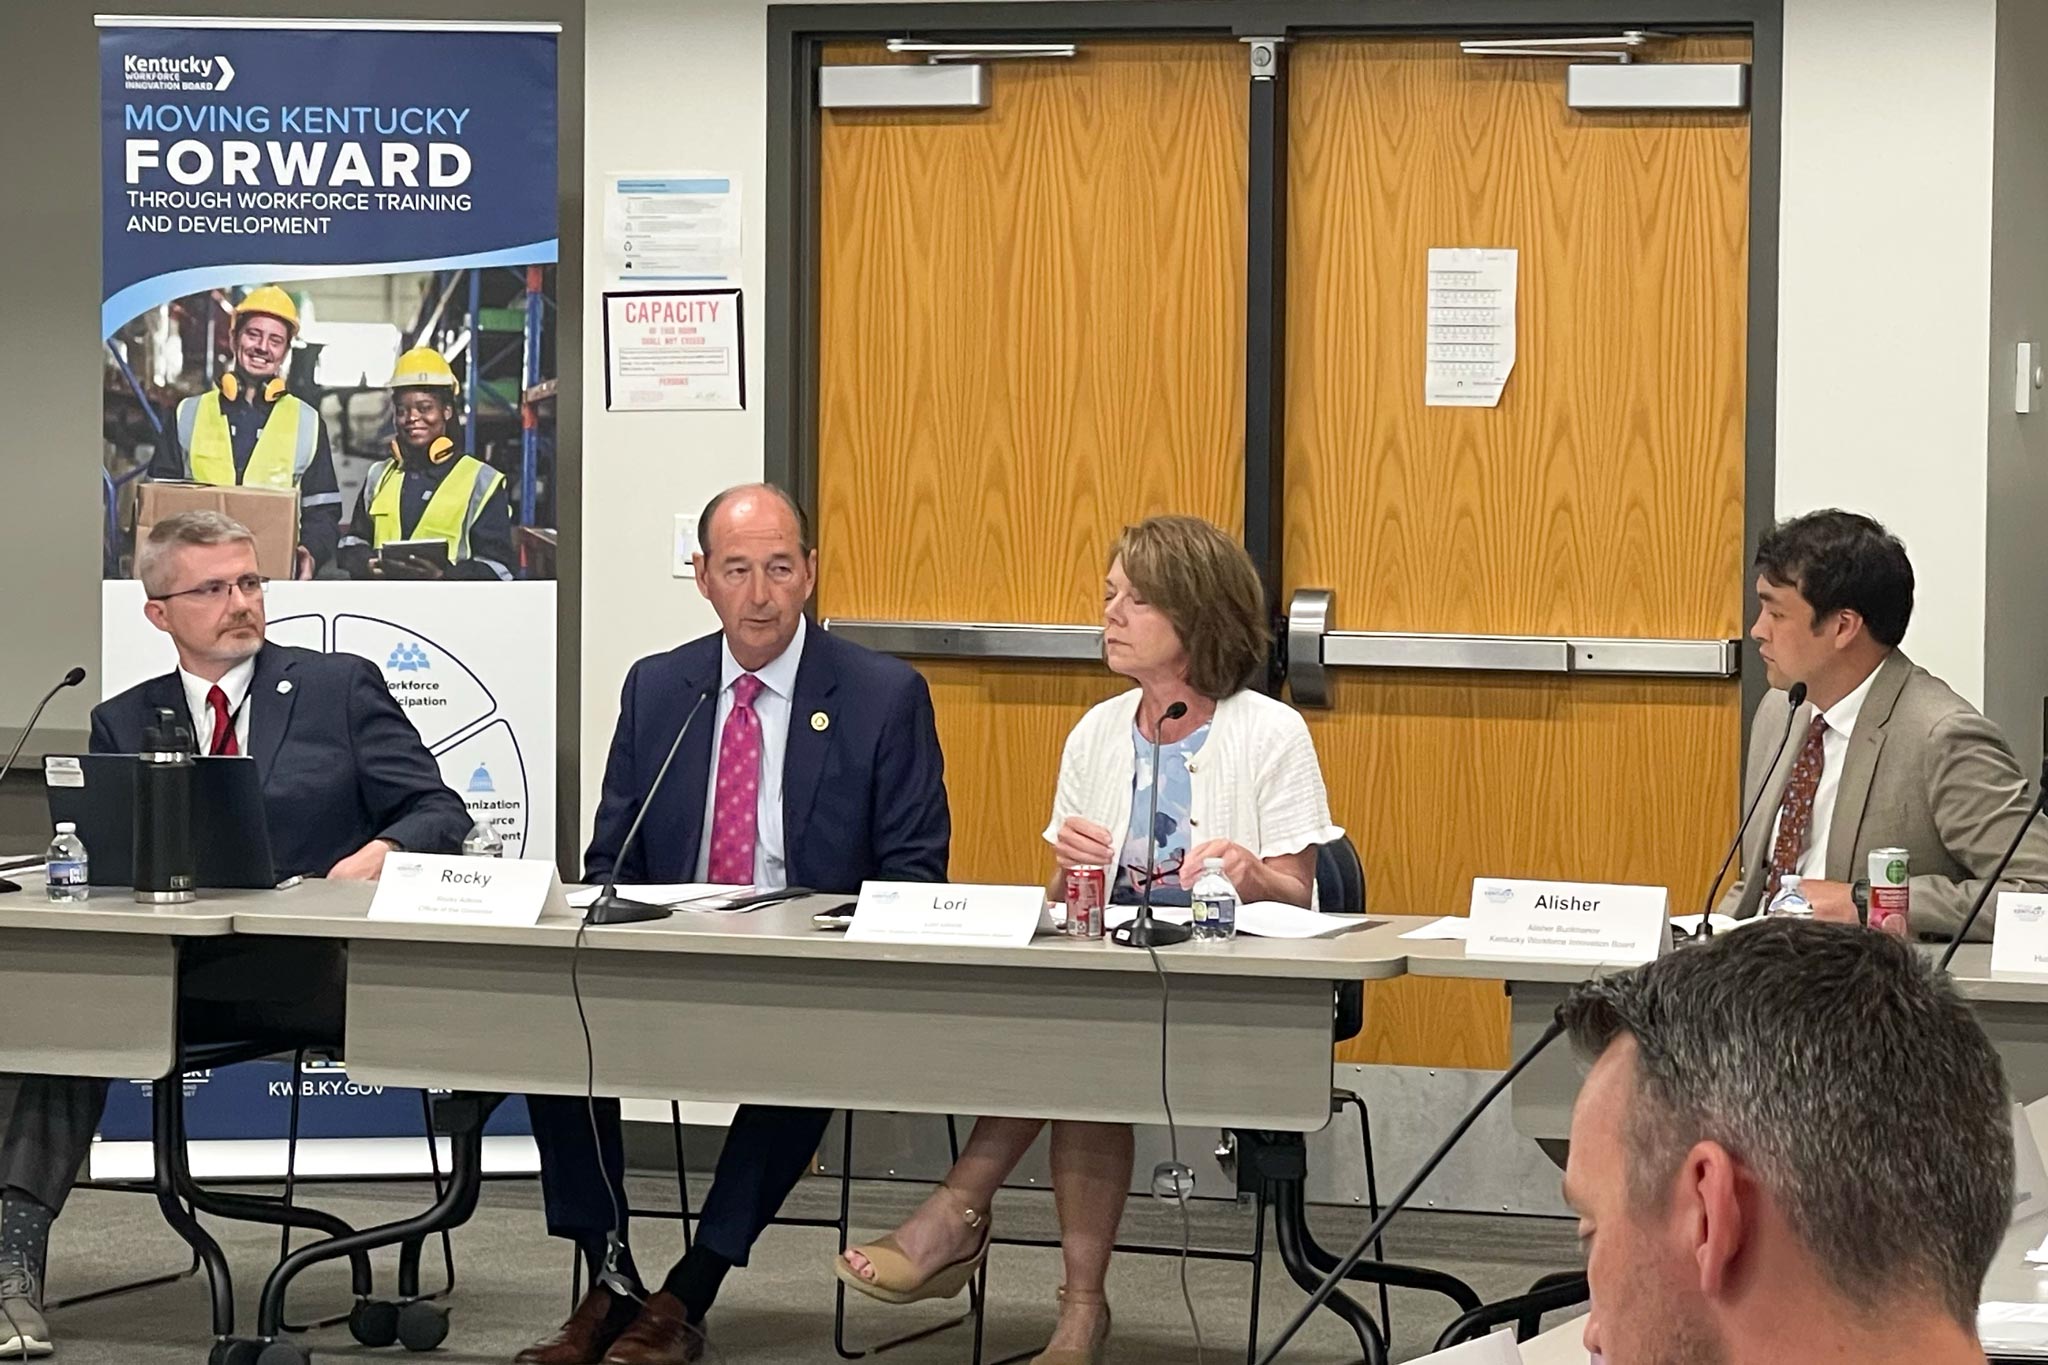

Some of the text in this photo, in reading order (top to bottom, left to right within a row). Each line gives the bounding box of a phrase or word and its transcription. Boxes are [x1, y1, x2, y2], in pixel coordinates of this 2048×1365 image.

[124, 55, 213, 78] Kentucky
[125, 72, 180, 81] WORKFORCE
[125, 81, 213, 91] INNOVATION BOARD
[125, 104, 470, 135] MOVING KENTUCKY
[126, 139, 472, 188] FORWARD
[126, 191, 472, 211] THROUGH WORKFORCE TRAINING
[126, 215, 331, 234] AND DEVELOPMENT
[624, 301, 720, 323] CAPACITY
[396, 695, 447, 708] cipation
[465, 800, 520, 809] anization
[441, 869, 492, 888] Rocky
[933, 897, 967, 911] Lori
[1534, 894, 1600, 911] Alisher
[1490, 935, 1525, 944] Kentucky
[268, 1080, 384, 1097] KWB.KY.GOV
